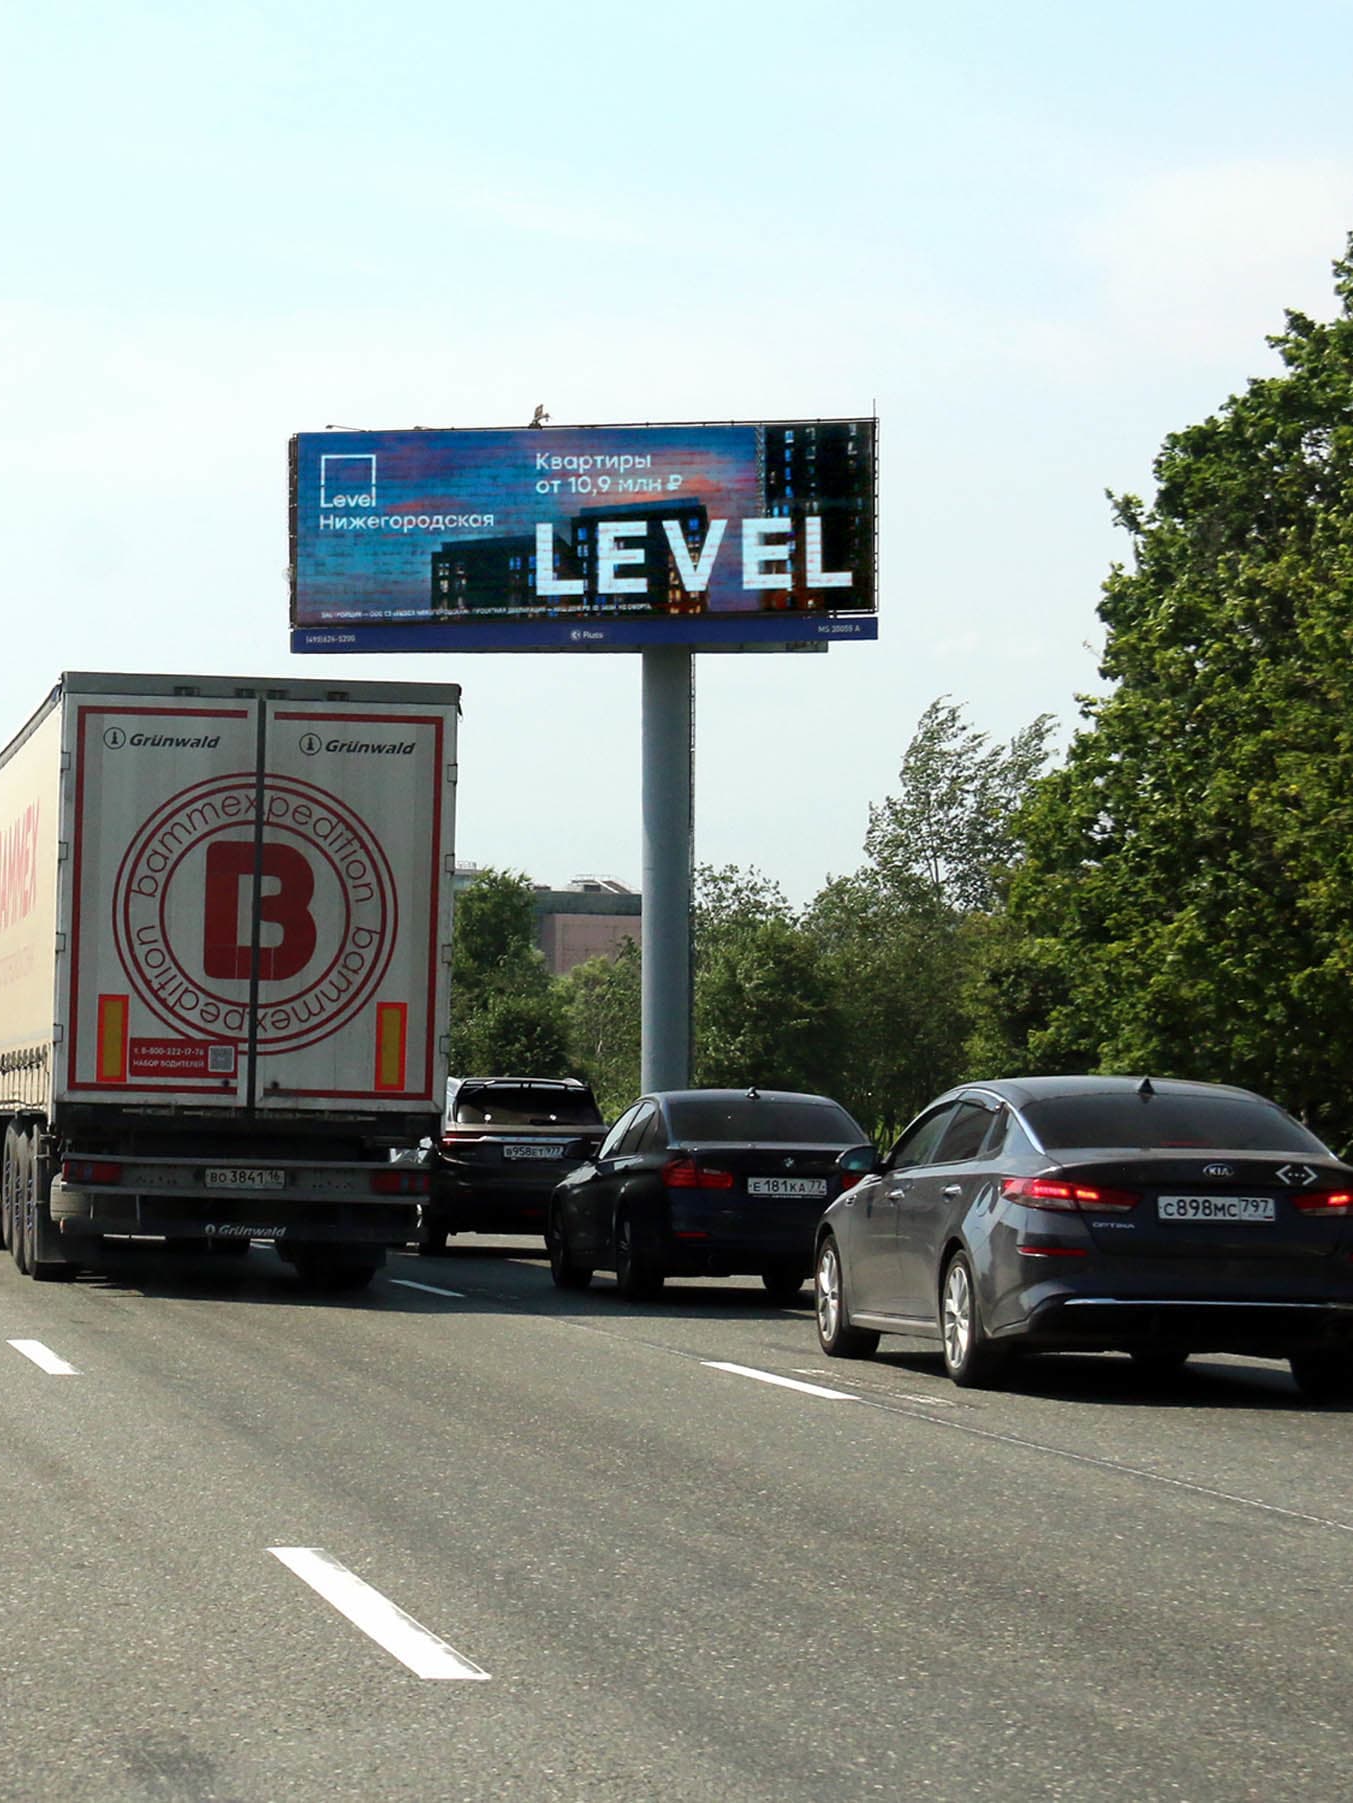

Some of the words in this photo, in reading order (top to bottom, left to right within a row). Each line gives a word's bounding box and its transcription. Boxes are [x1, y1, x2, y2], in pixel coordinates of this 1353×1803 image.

[535, 452, 651, 473] Квартиры
[535, 480, 561, 494] от
[568, 475, 612, 497] 10,9
[618, 478, 662, 493] млн
[320, 485, 376, 508] Level
[319, 513, 495, 533] Нижегородская
[535, 515, 853, 596] LEVEL
[129, 733, 221, 749] Grünwald
[324, 739, 416, 756] Grünwald
[1209, 1167, 1229, 1177] KIA
[218, 1225, 287, 1237] Grünwald
